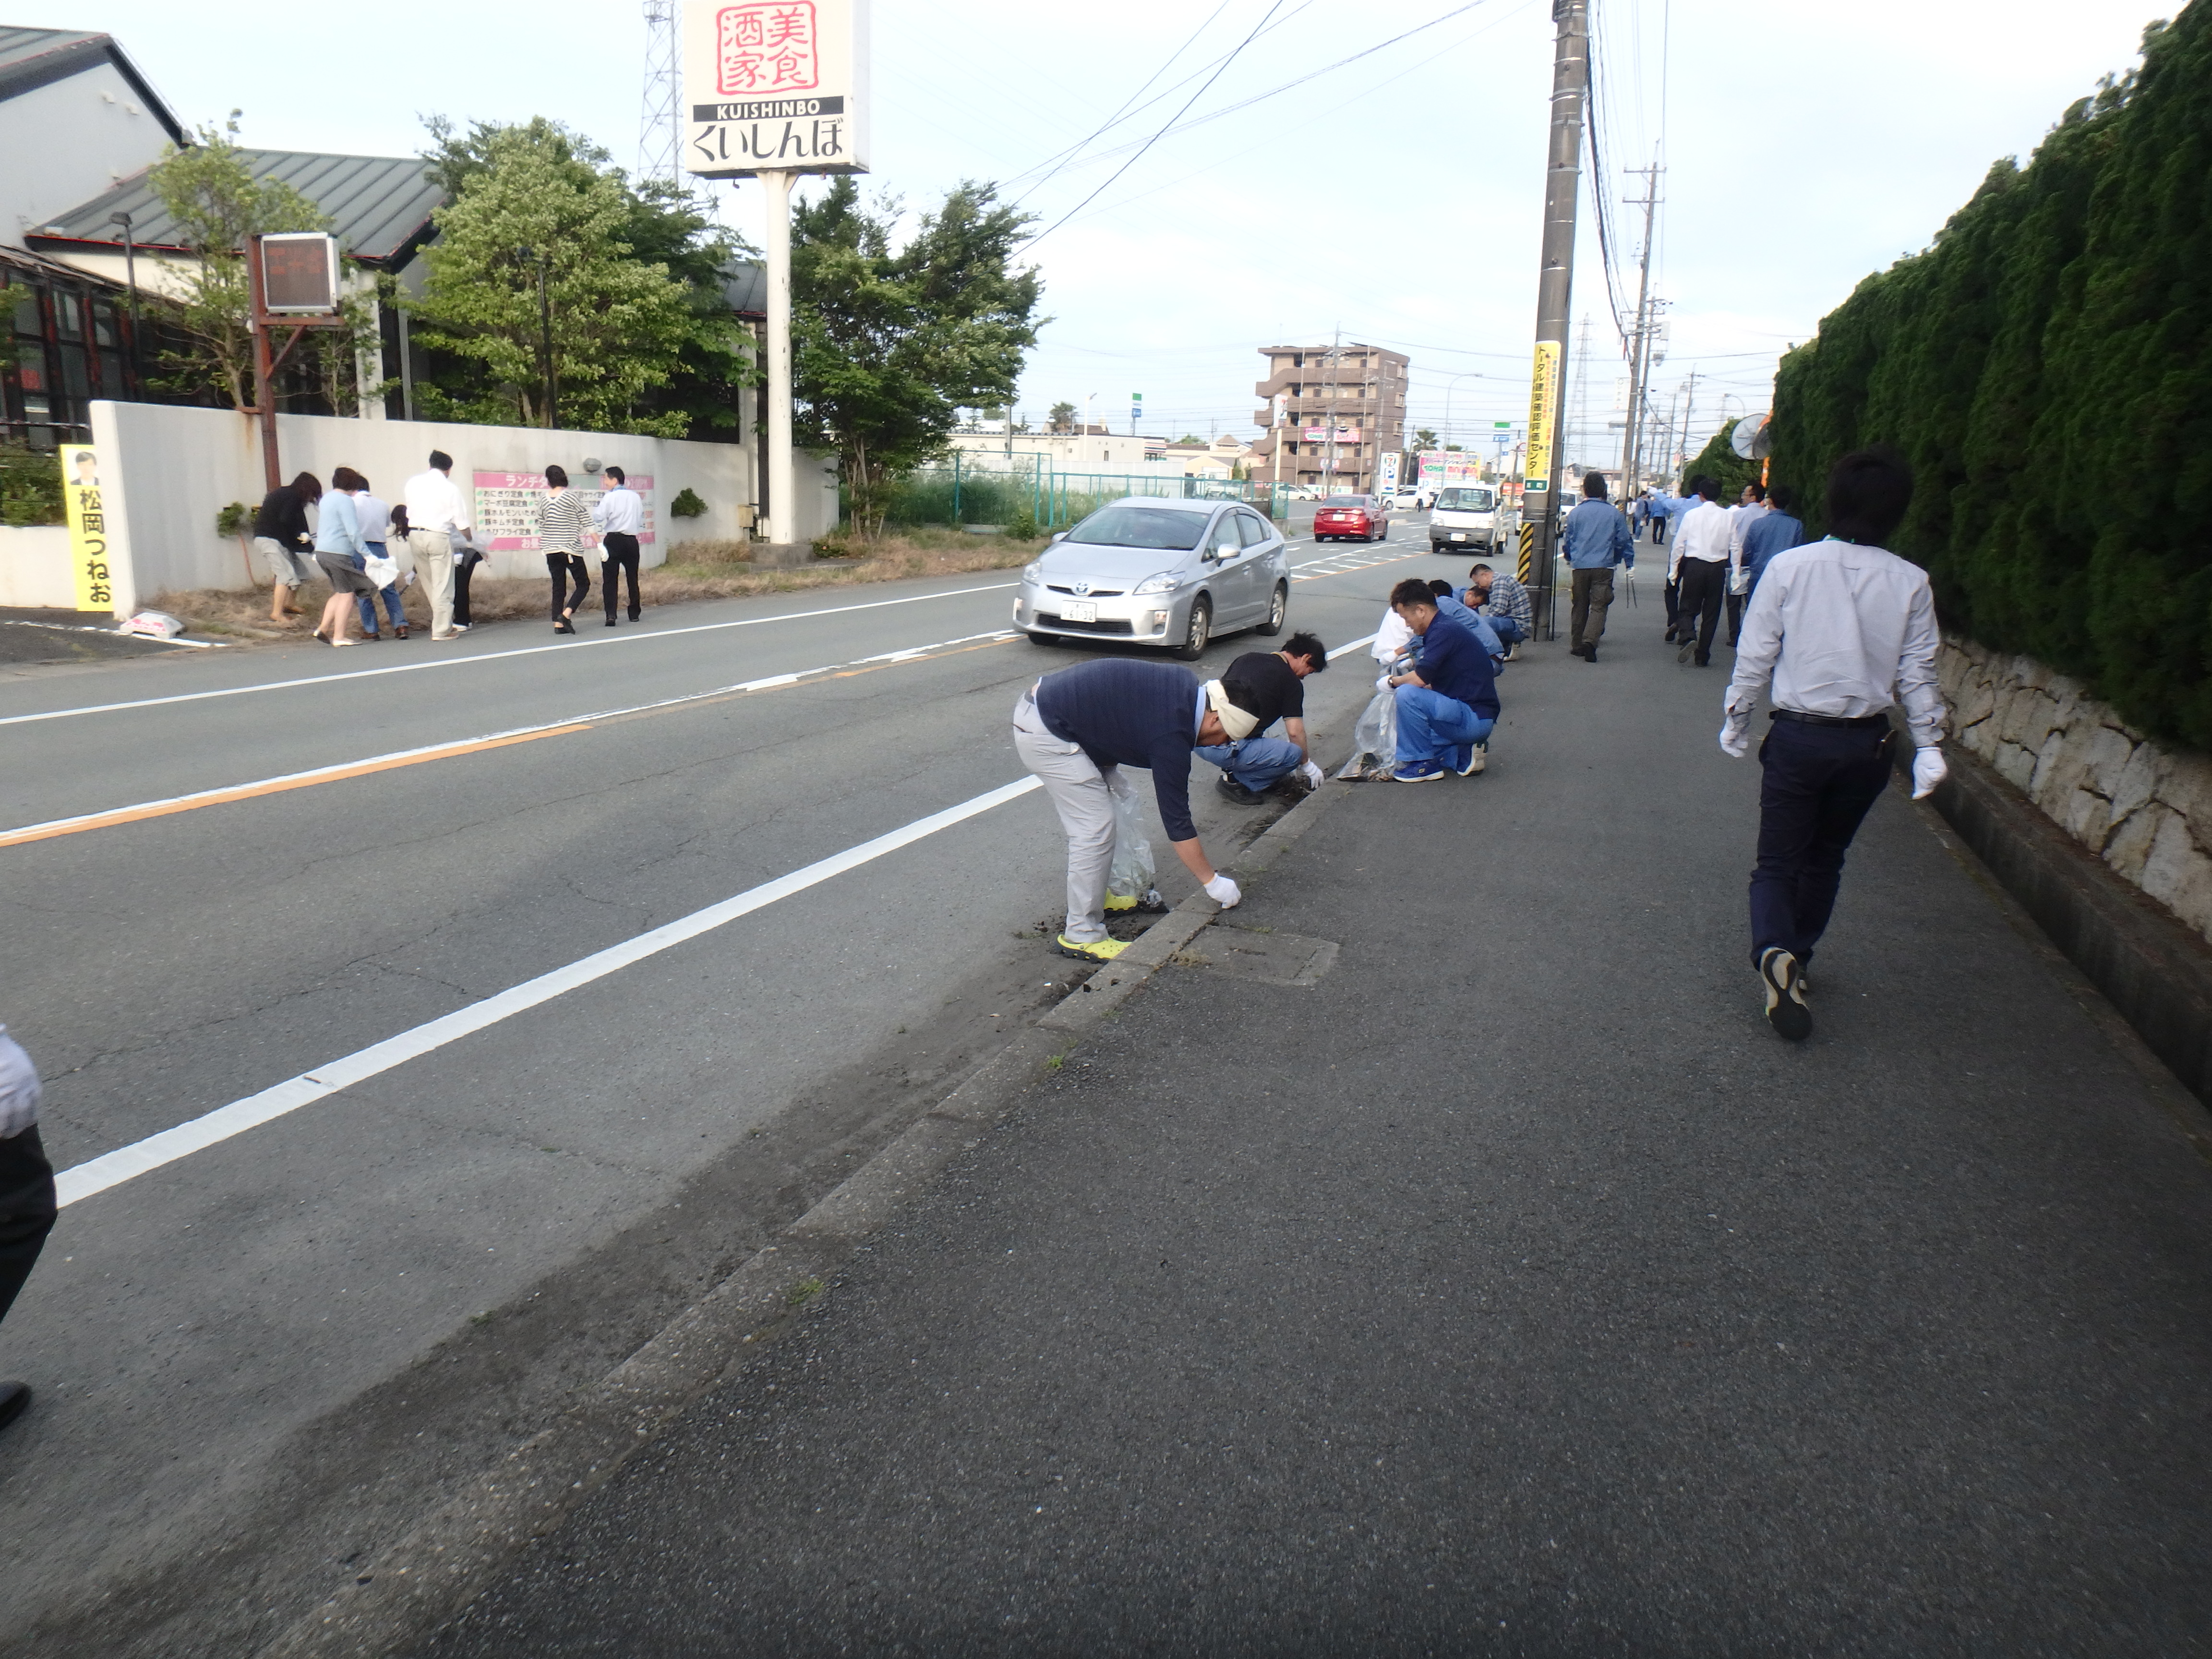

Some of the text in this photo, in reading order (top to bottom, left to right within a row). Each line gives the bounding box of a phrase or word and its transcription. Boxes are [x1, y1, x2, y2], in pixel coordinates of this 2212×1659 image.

[717, 99, 820, 120] KUISHINBO
[693, 117, 843, 162] くいしんぼ
[1385, 468, 1395, 479] P
[79, 489, 111, 603] 松岡つねお
